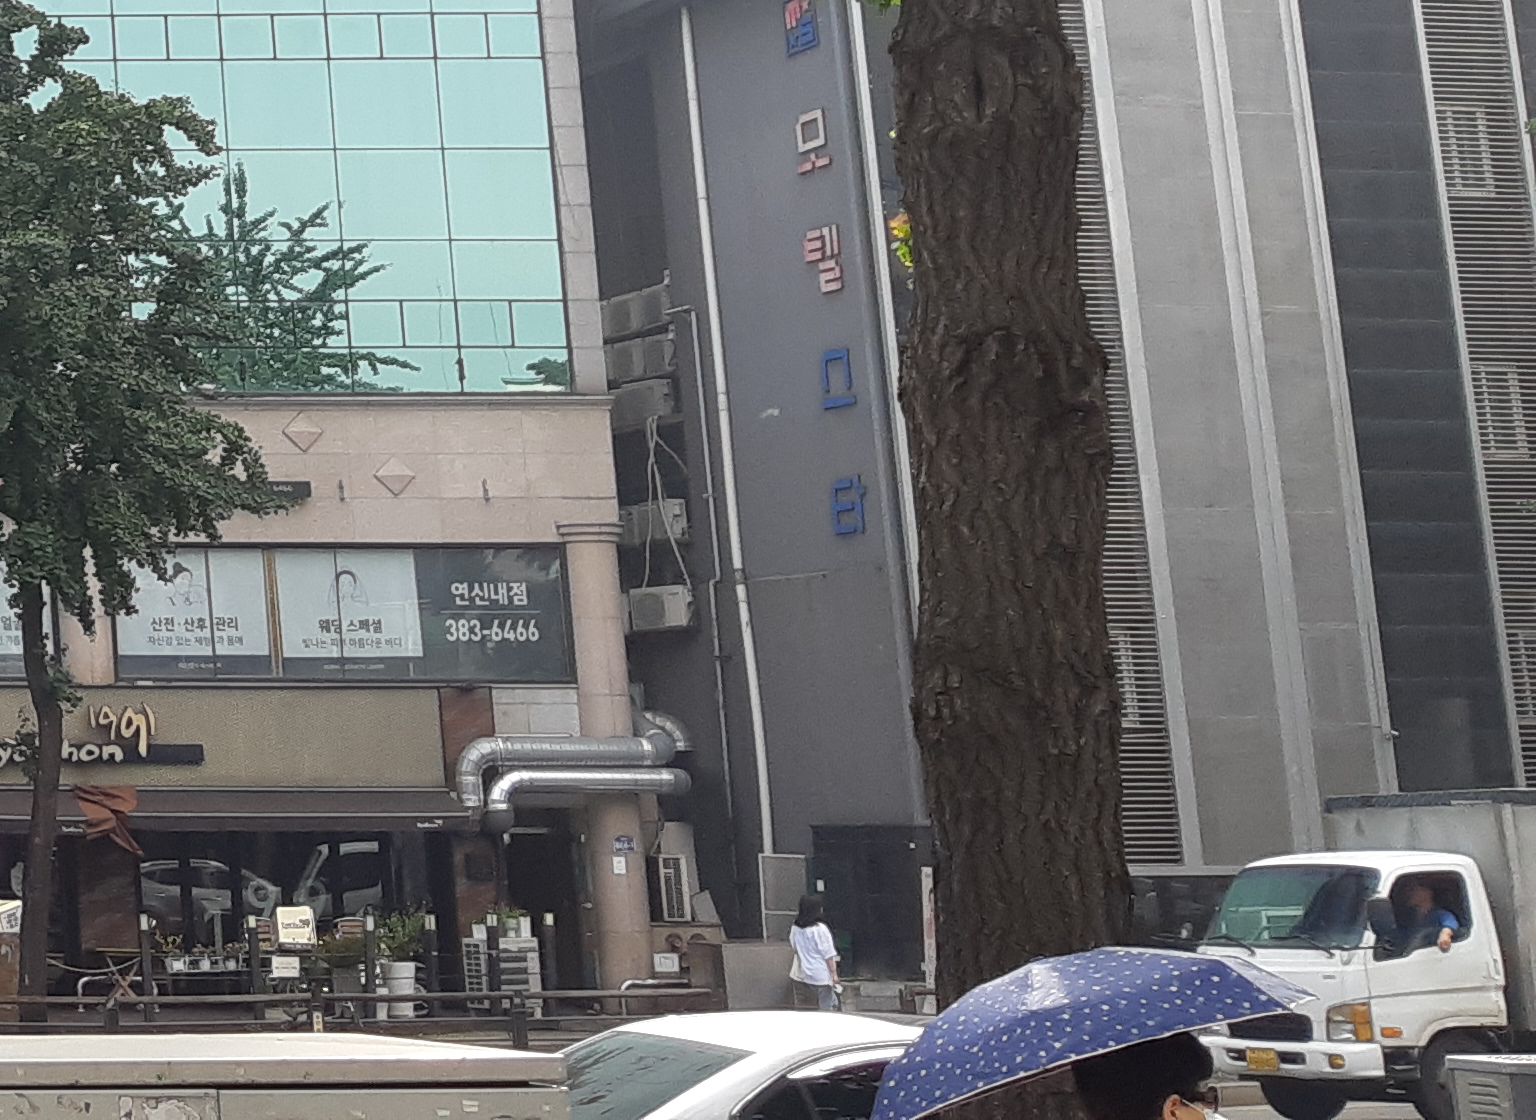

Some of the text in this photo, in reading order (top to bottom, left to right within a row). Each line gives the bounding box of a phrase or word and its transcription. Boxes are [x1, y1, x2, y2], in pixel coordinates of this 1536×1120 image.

[449, 581, 529, 607] 연신내점
[214, 616, 240, 632] 관리
[444, 618, 541, 643] 383-6466
